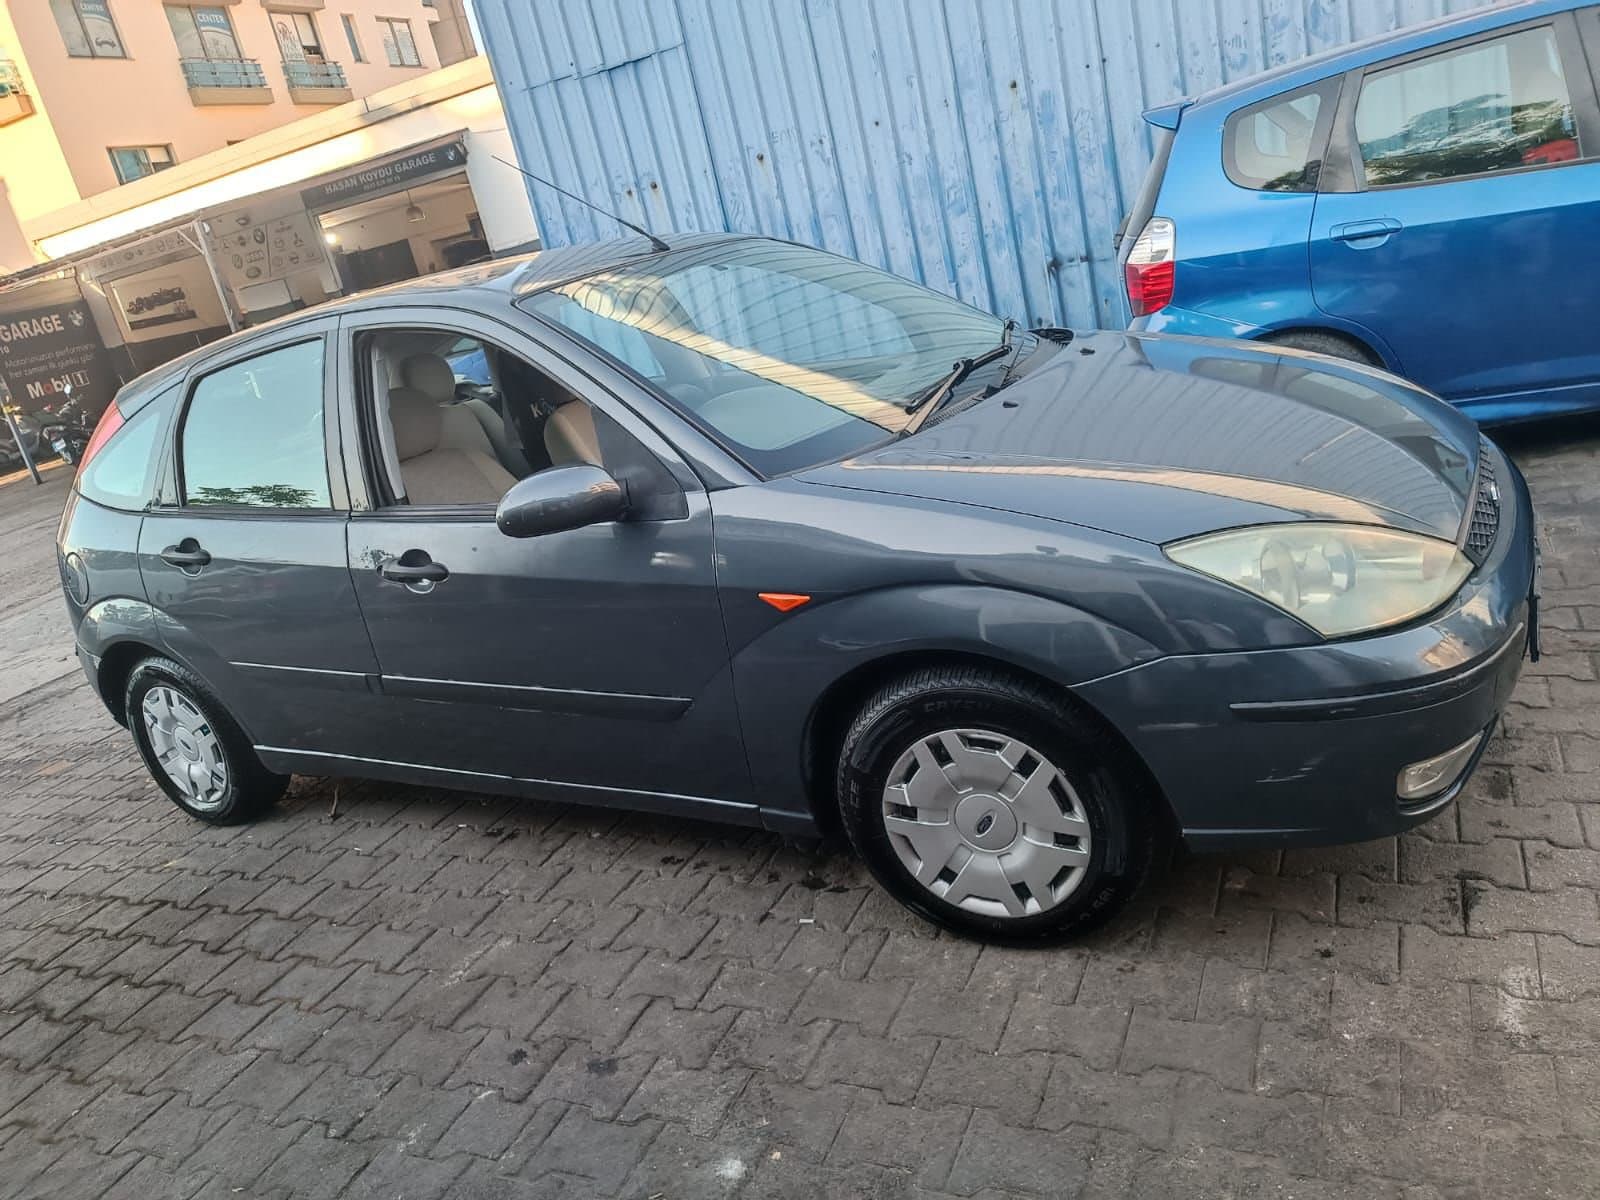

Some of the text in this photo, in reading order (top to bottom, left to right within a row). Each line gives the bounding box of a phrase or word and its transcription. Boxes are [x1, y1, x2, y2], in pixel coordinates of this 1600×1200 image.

[197, 12, 225, 24] CENTER
[324, 176, 358, 195] HASAN
[394, 153, 436, 173] GARAGE
[0, 314, 65, 342] GARAGE
[26, 374, 72, 399] Mobil
